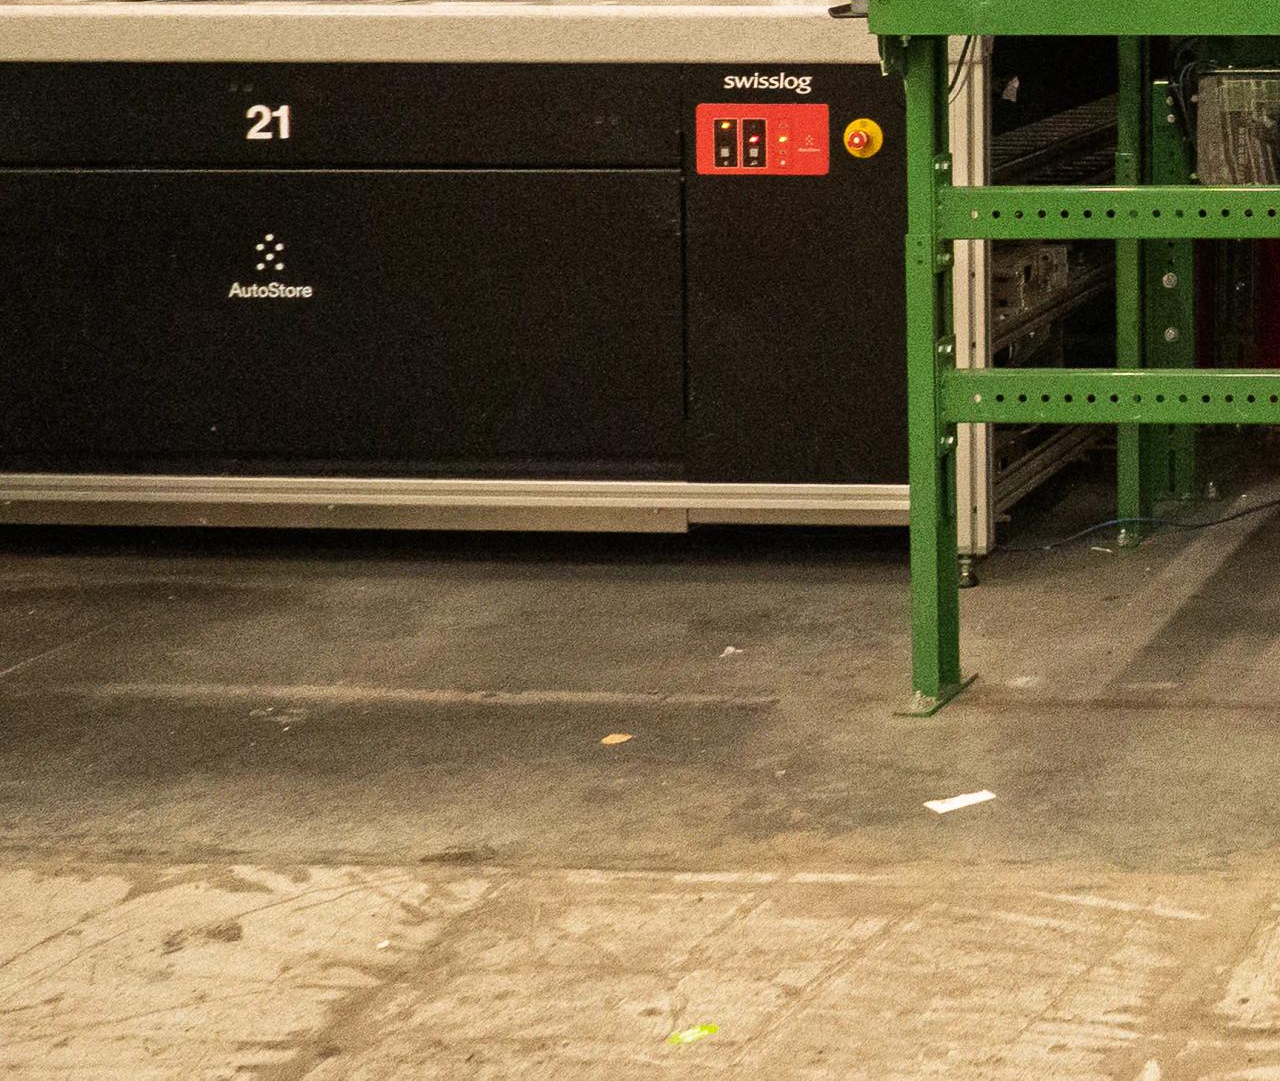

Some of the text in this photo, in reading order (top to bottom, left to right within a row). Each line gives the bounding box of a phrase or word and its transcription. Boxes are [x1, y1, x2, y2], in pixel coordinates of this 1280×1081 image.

[724, 72, 812, 94] swisslog
[245, 104, 290, 140] 21
[228, 282, 313, 299] AutoStore
